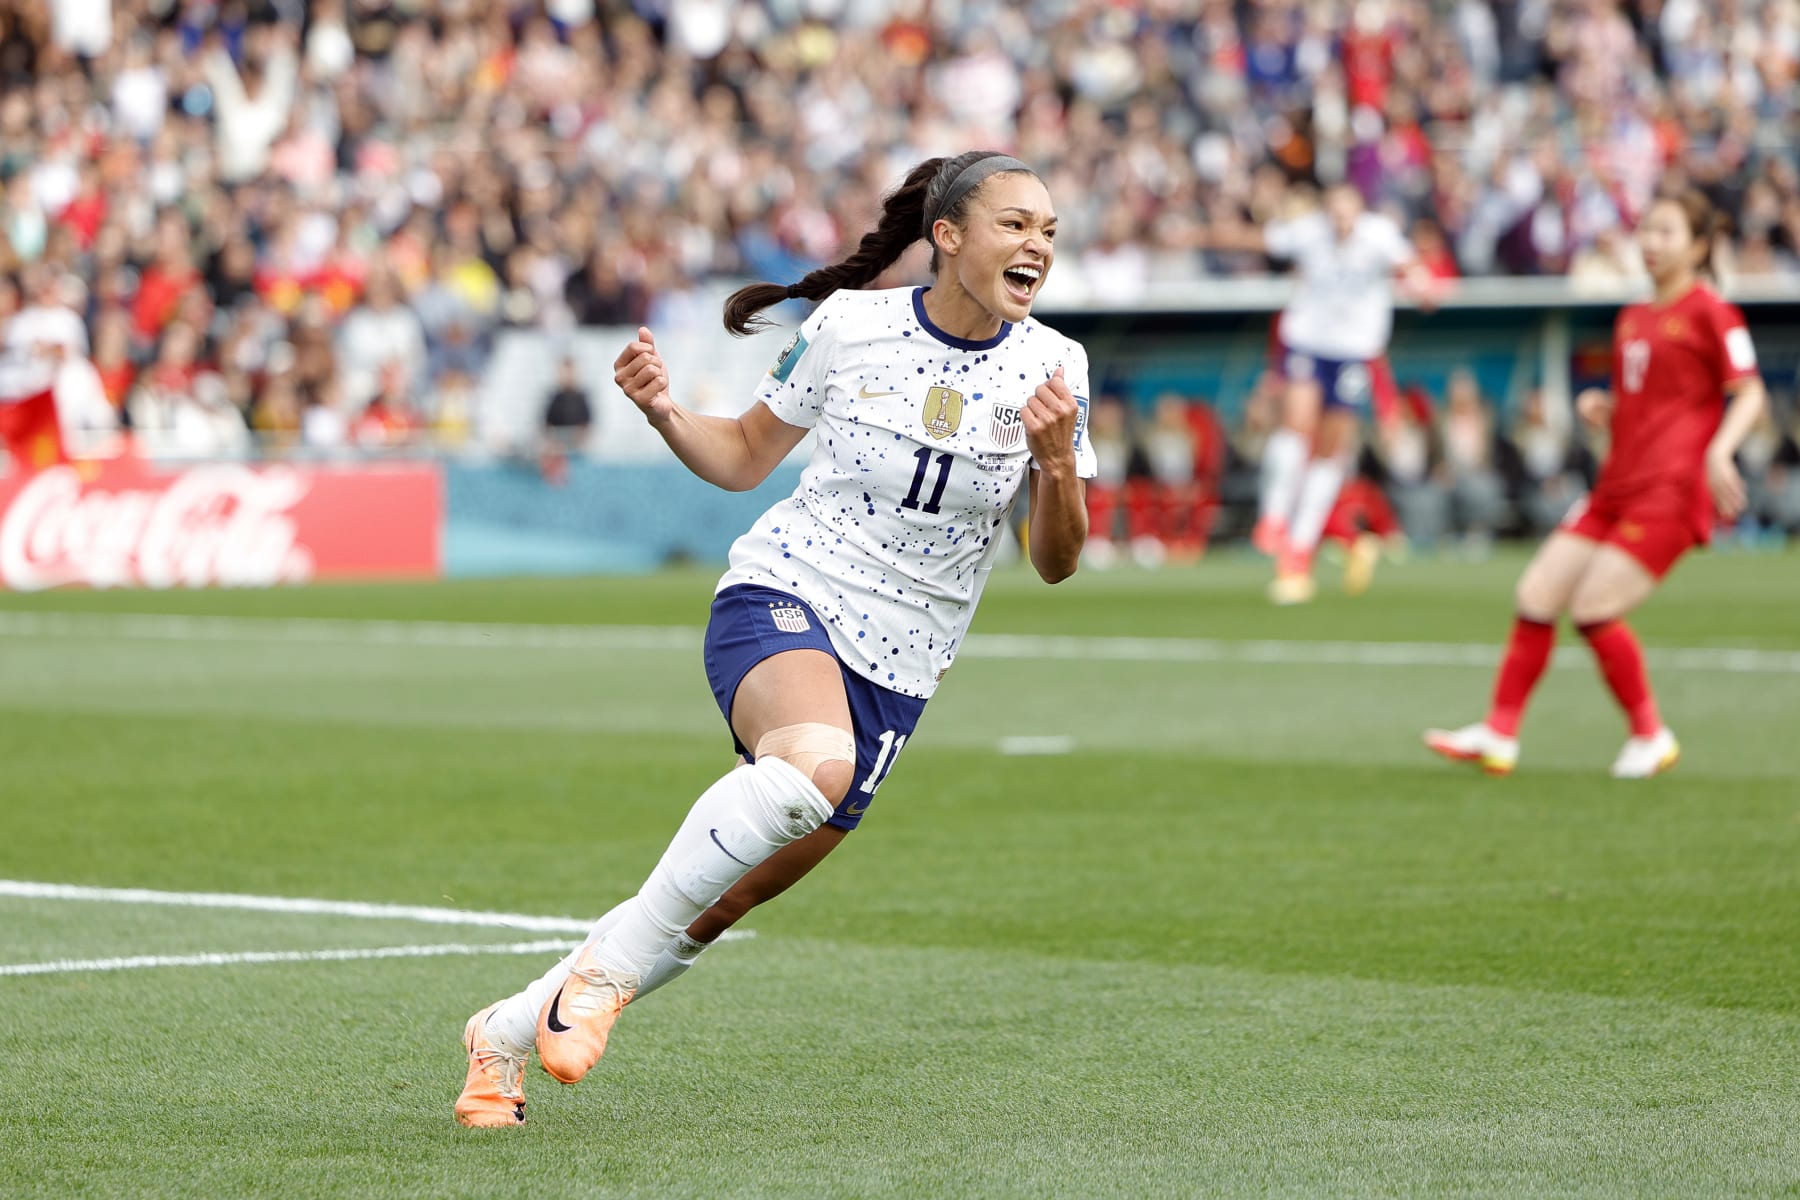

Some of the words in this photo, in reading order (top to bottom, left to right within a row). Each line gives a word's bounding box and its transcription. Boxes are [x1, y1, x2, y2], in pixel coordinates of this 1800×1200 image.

[995, 406, 1021, 425] USA
[931, 418, 949, 429] FIFA
[901, 447, 954, 514] 11
[773, 609, 803, 619] USA
